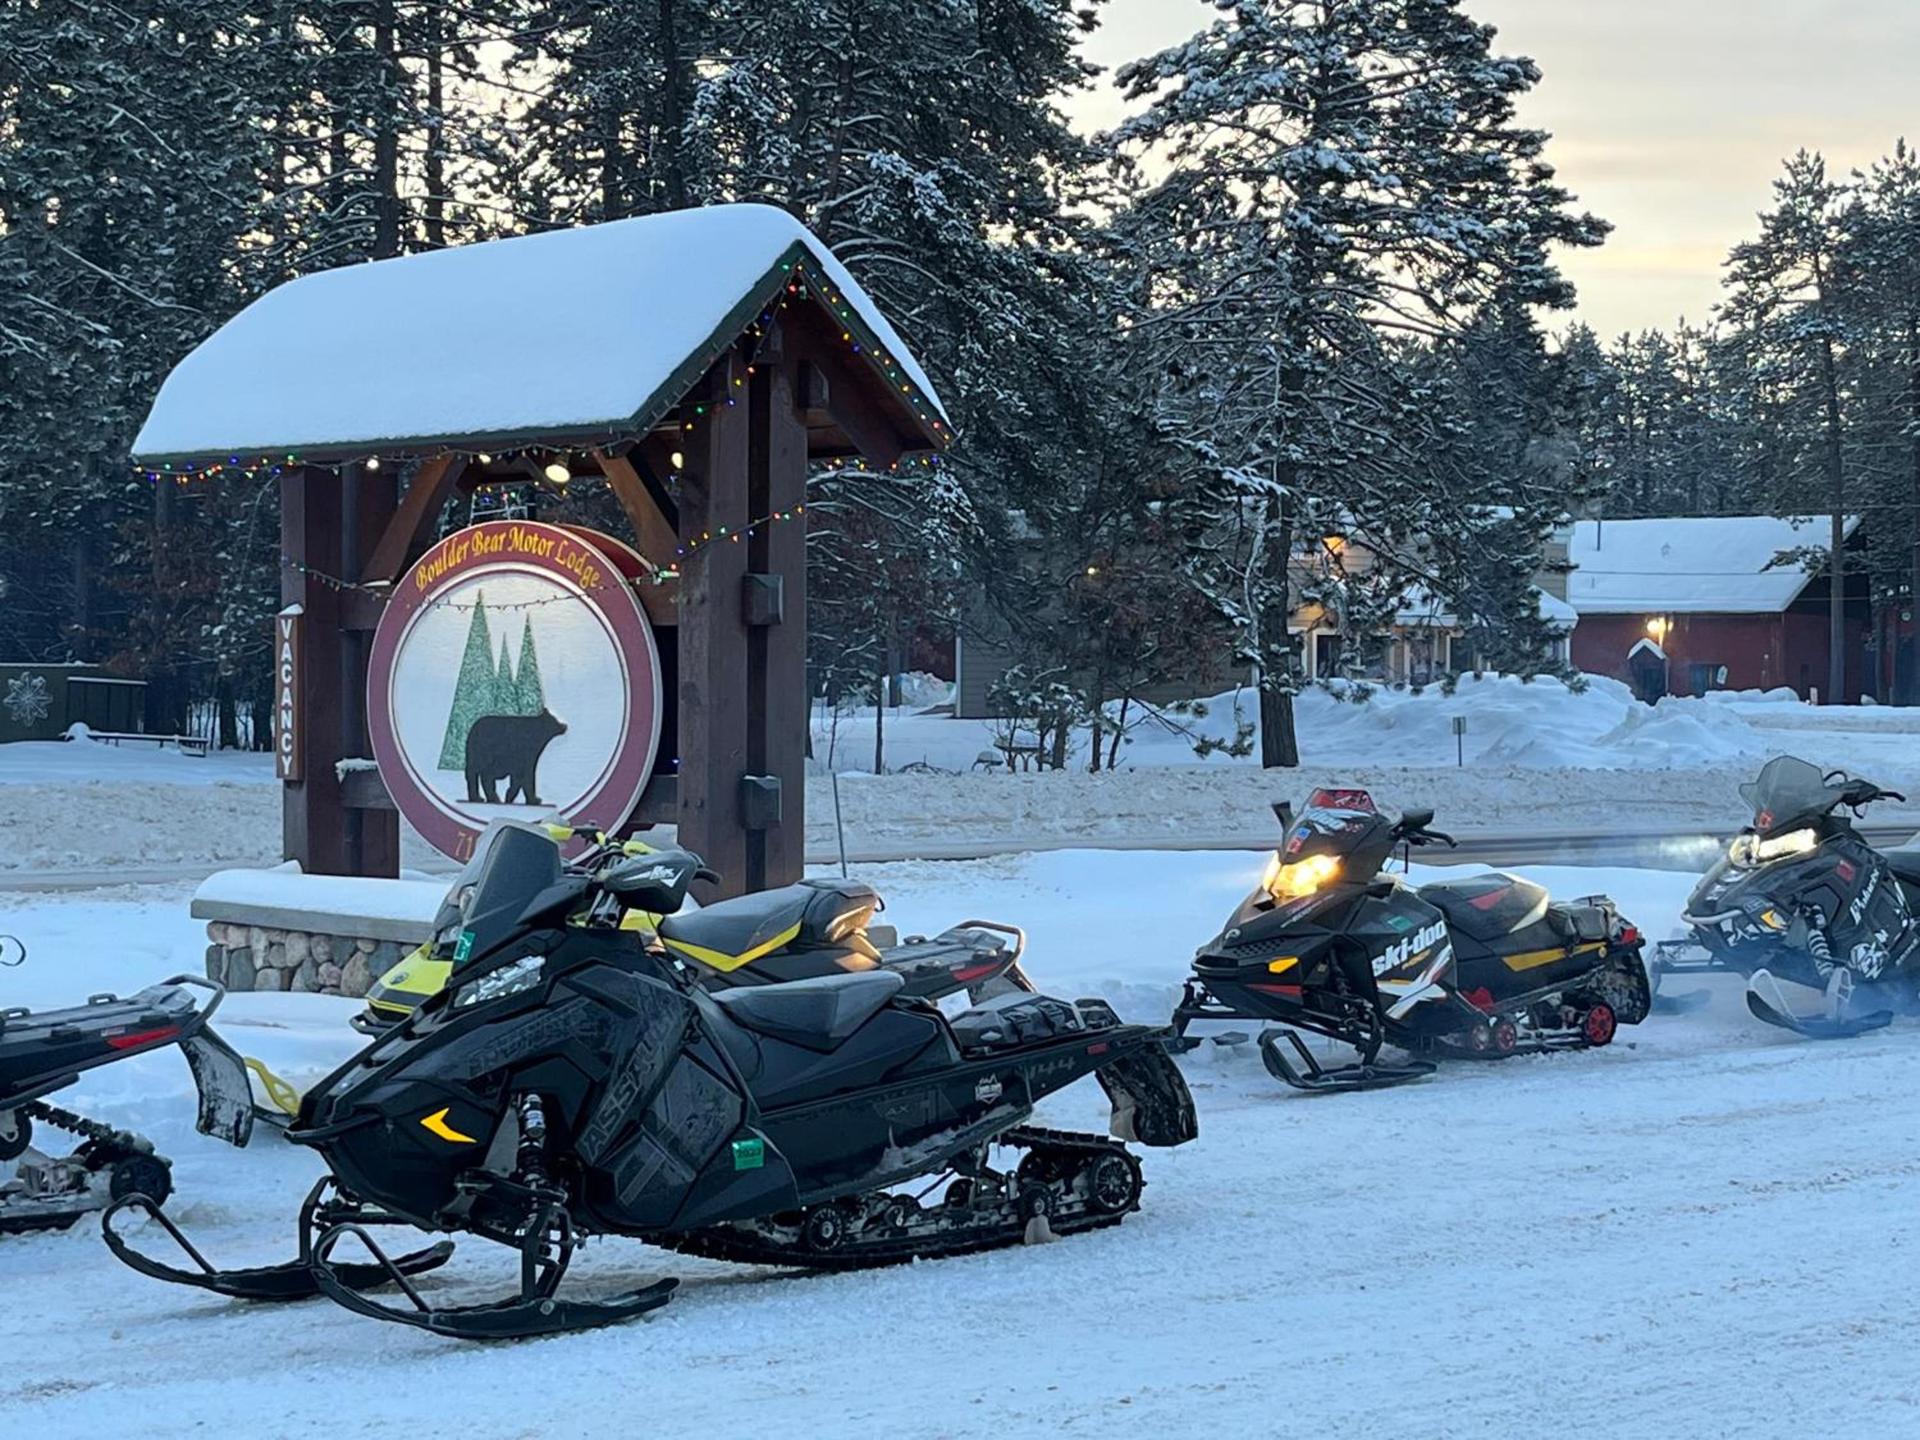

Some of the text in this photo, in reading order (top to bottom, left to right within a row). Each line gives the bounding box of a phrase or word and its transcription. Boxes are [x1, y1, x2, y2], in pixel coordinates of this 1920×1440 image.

[415, 526, 600, 592] Boulder Bear Motor Lodge
[280, 619, 293, 776] VACANCY
[575, 1000, 680, 1166] ASSAU
